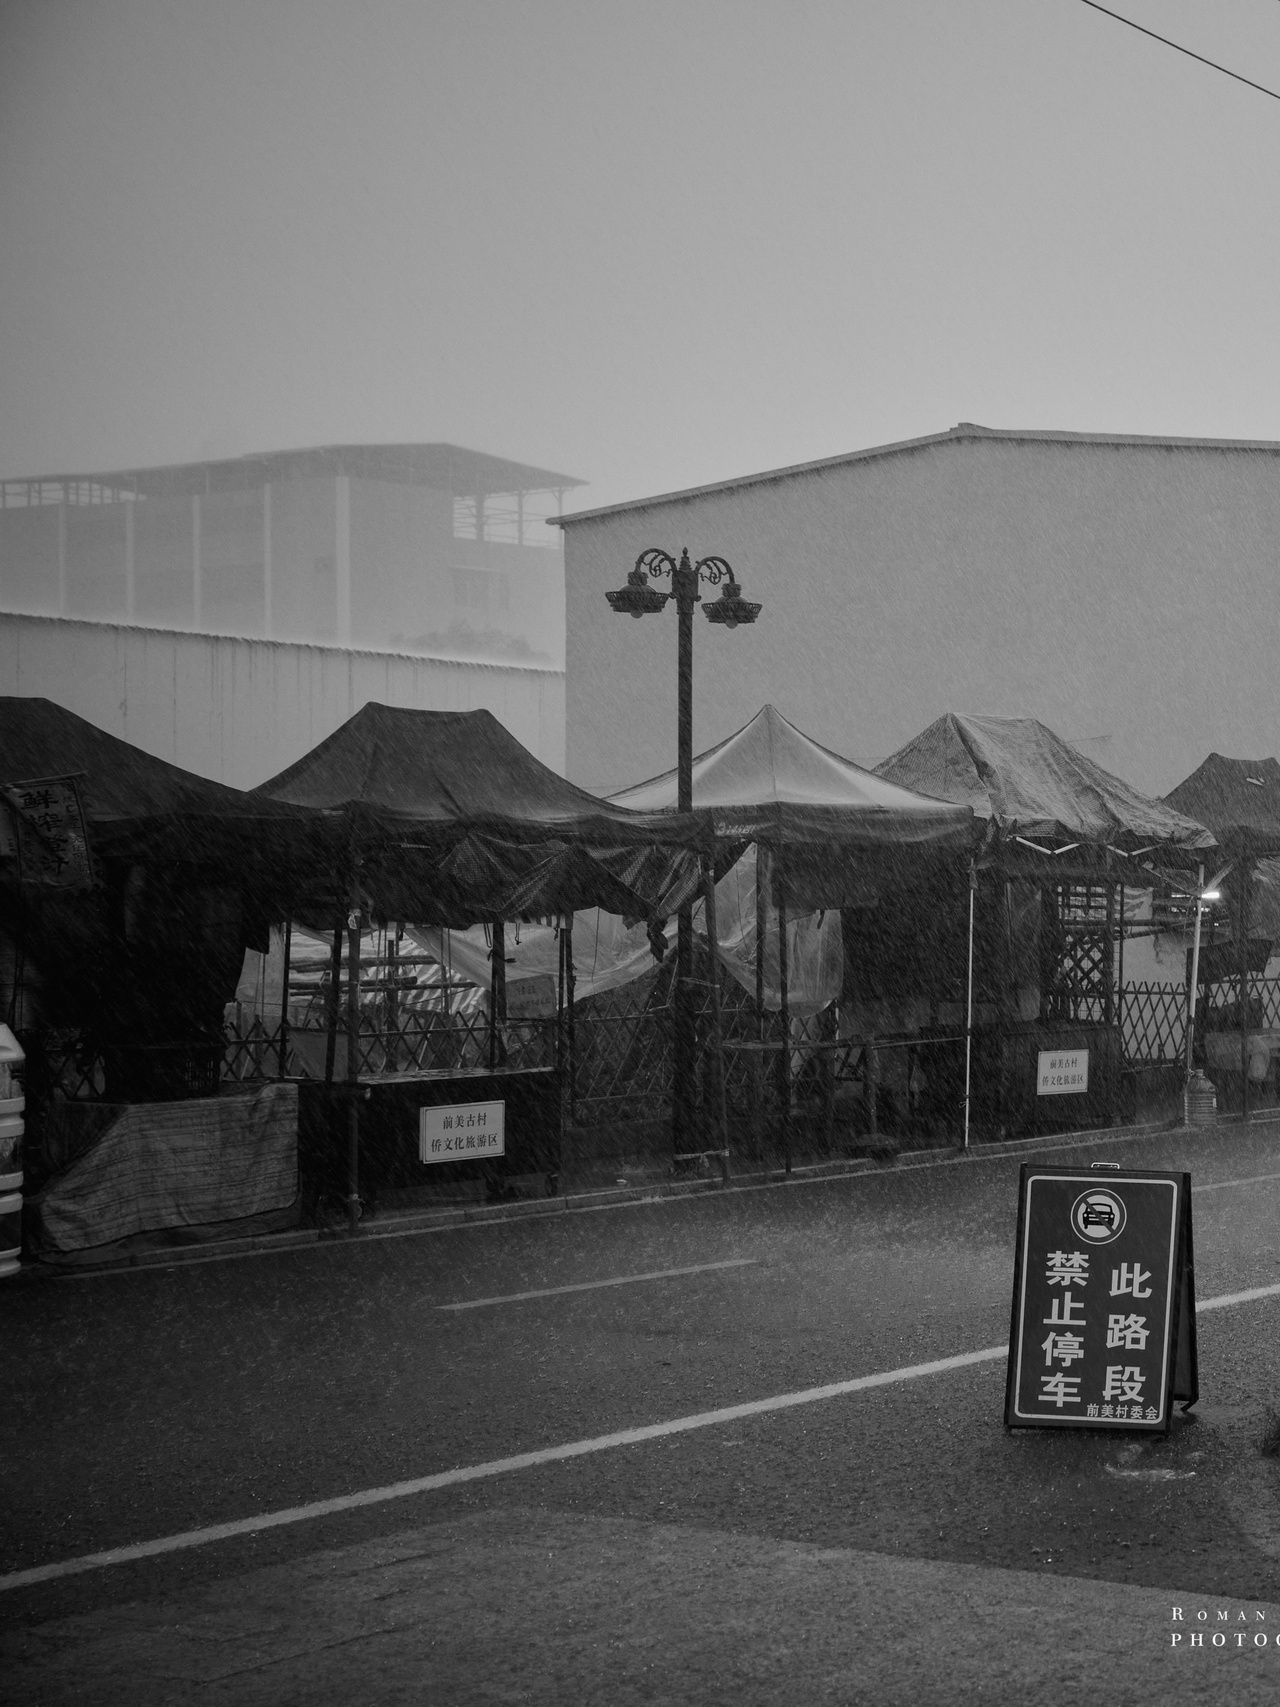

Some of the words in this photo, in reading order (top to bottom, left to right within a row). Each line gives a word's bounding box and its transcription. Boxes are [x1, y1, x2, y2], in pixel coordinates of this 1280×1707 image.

[443, 1112, 487, 1129] 前美古村
[431, 1133, 498, 1152] 侨文化旅游区
[1038, 1250, 1090, 1408] 禁止停车
[1102, 1262, 1153, 1403] 此路段
[1086, 1403, 1159, 1420] 前美村委会
